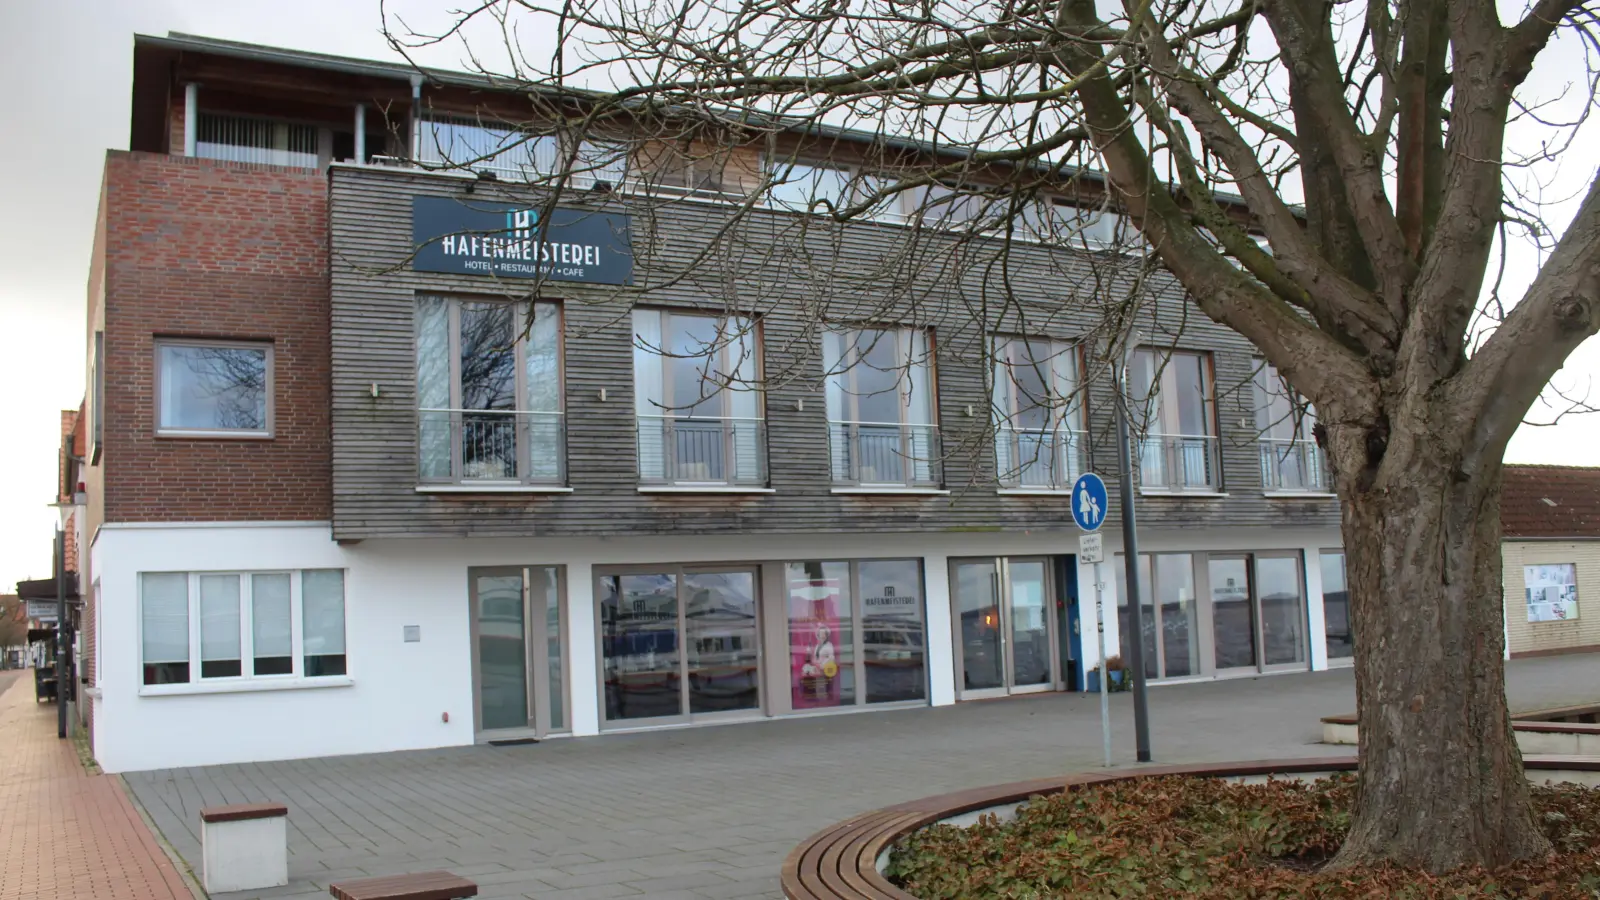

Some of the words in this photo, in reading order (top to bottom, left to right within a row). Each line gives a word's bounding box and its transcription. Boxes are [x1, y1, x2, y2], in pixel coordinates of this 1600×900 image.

[442, 235, 600, 266] HAFENMEISTEREI
[464, 260, 492, 271] HOTEL
[562, 267, 585, 277] CAFE
